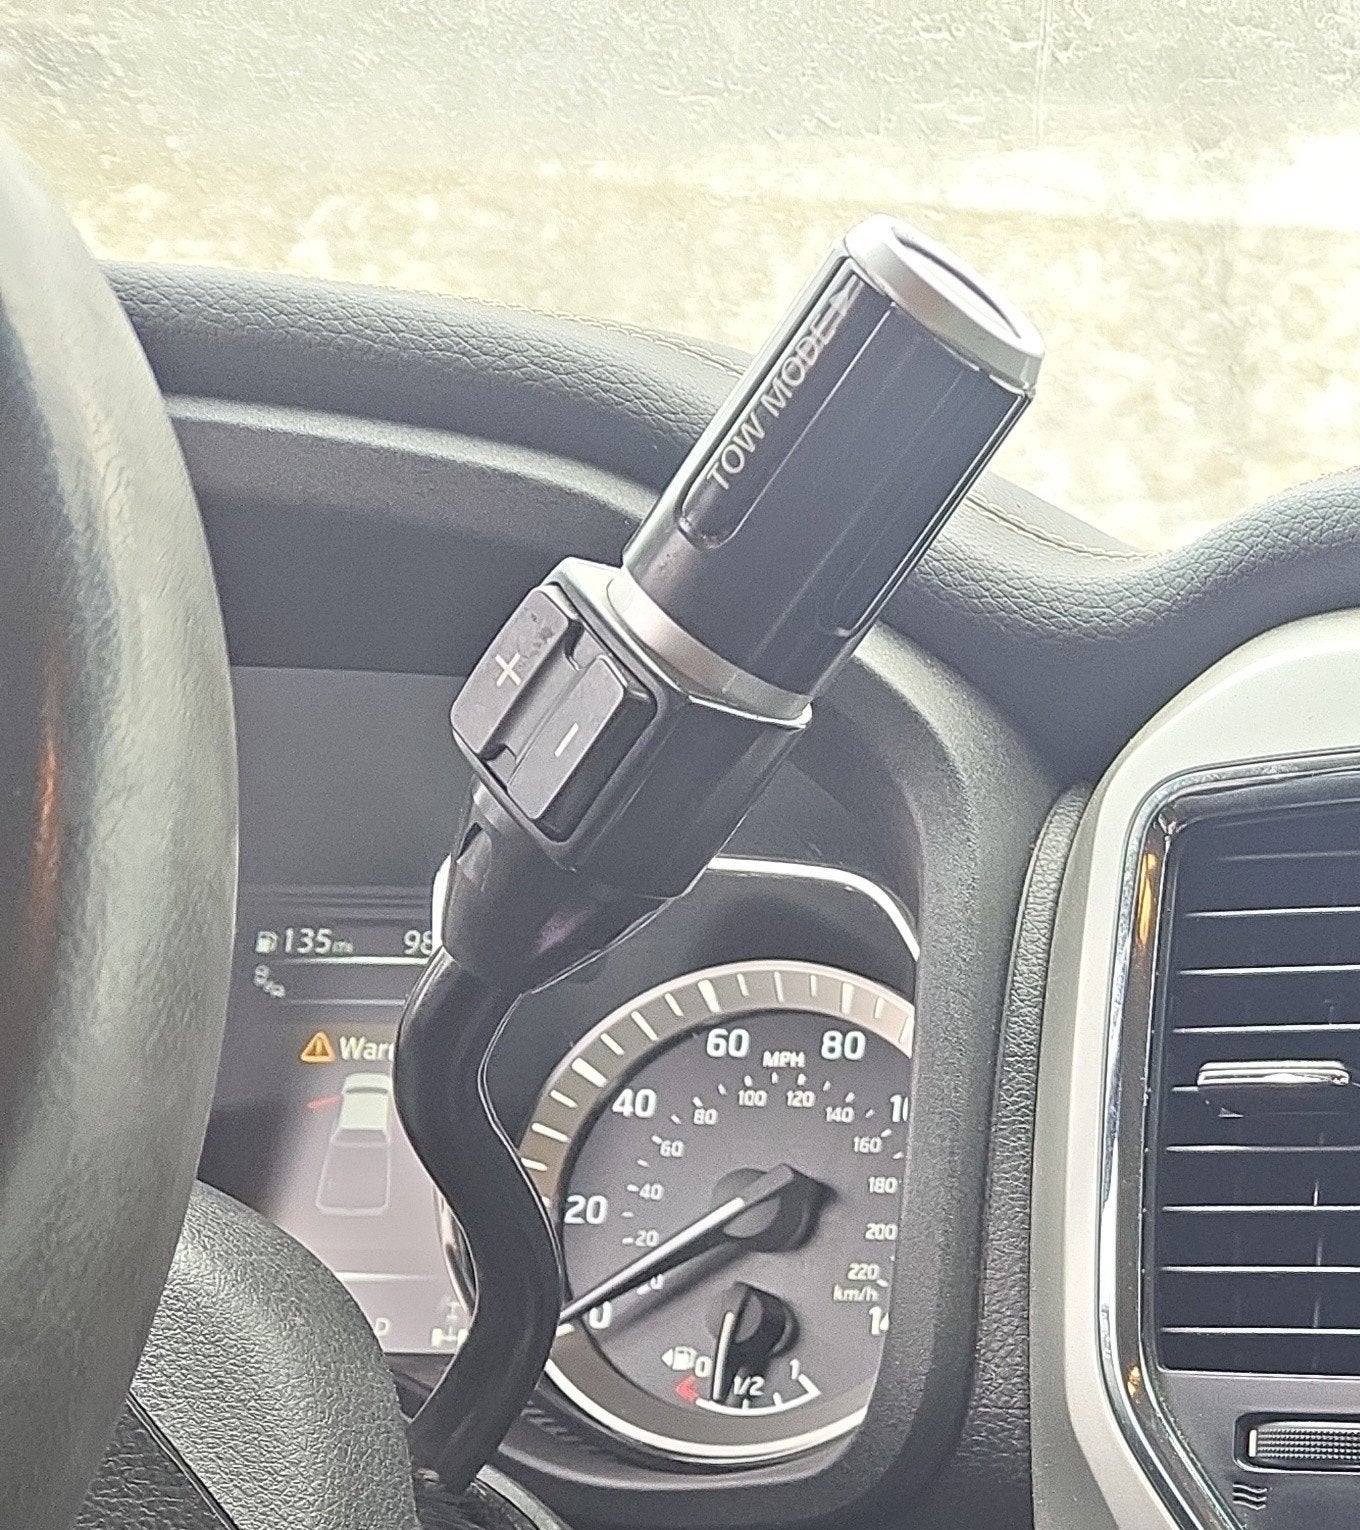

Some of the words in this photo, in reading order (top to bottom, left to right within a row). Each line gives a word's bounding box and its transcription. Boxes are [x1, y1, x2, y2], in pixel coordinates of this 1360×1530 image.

[706, 411, 766, 490] TOW
[761, 318, 836, 418] MODE
[285, 928, 332, 953] 135
[706, 1028, 750, 1058] 60
[820, 1030, 866, 1060] 80
[762, 1051, 805, 1069] MPH
[612, 1089, 657, 1118] 40
[738, 1090, 767, 1107] 100
[786, 1090, 815, 1108] 120
[693, 1108, 718, 1125] 80
[825, 1107, 854, 1123] 140
[660, 1140, 684, 1158] 60
[853, 1136, 882, 1153] 160
[639, 1184, 664, 1200] 40
[868, 1177, 898, 1194] 180
[564, 1195, 608, 1225] 20
[635, 1230, 660, 1247] 20
[865, 1223, 898, 1241] 200
[848, 1264, 879, 1281] 220
[833, 1285, 879, 1301] km/h
[588, 1300, 612, 1330] 0
[695, 1357, 712, 1378] 0
[789, 1360, 801, 1380] 1
[733, 1376, 765, 1396] 1/2
